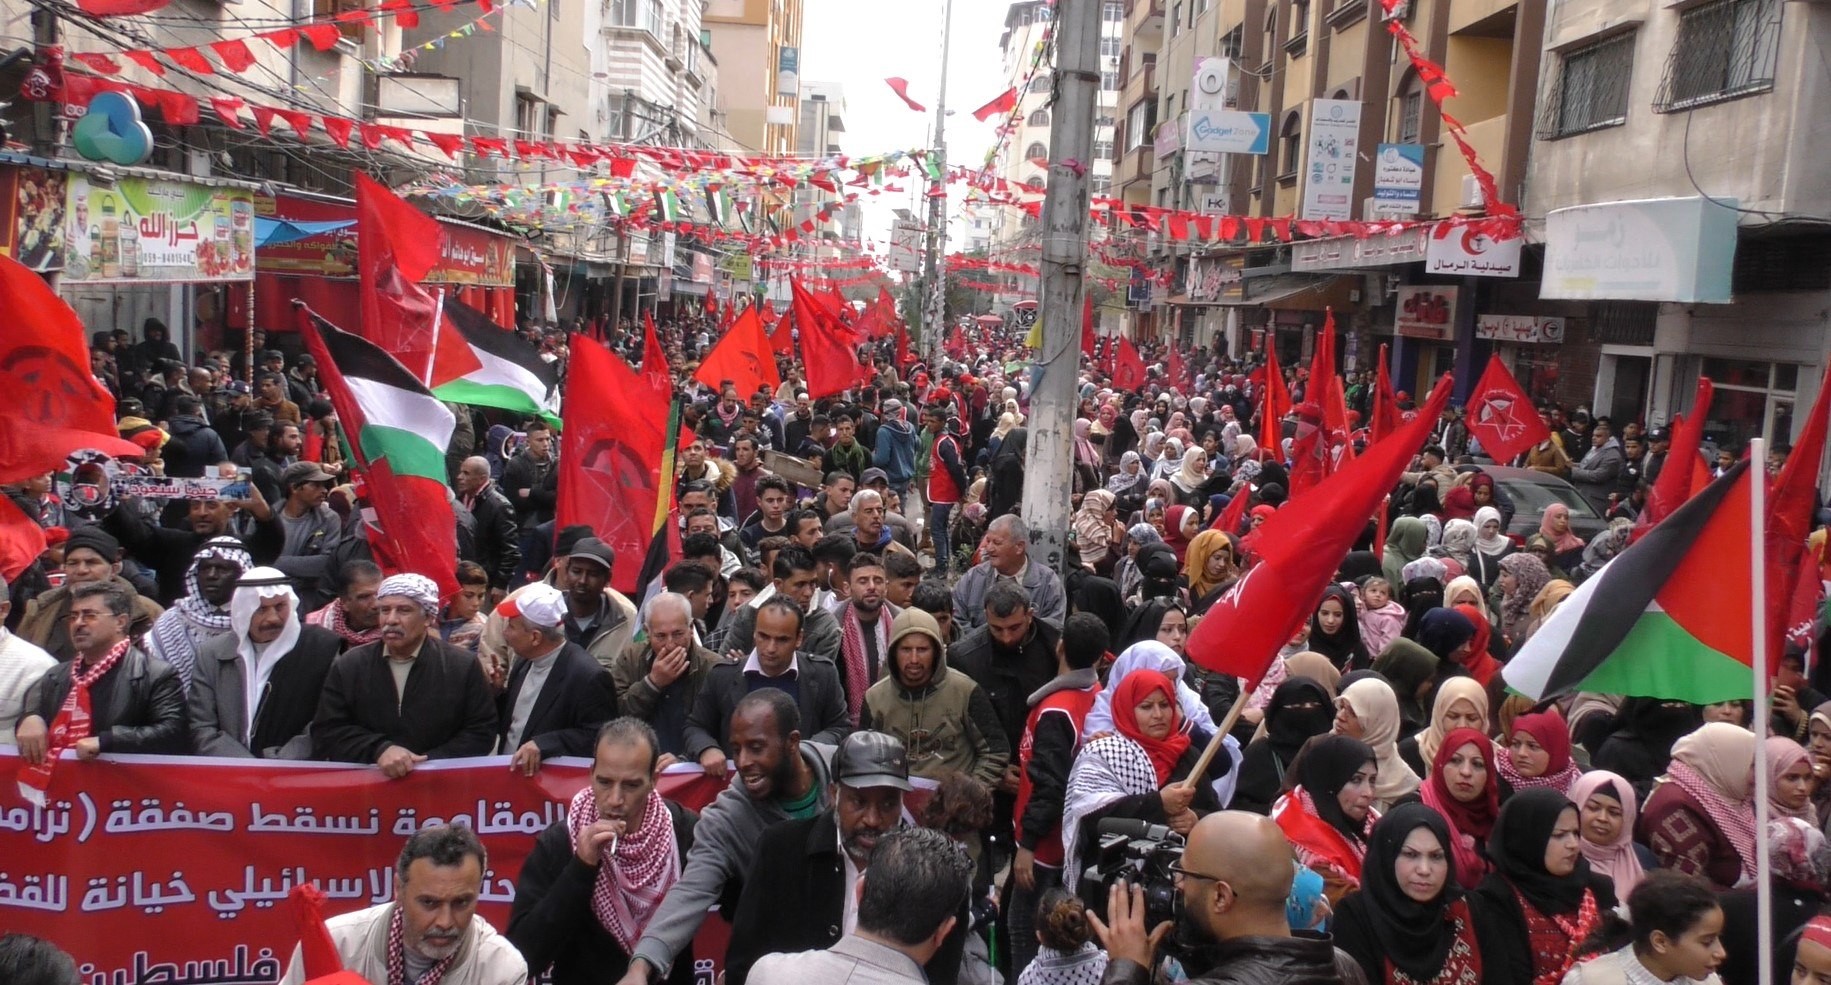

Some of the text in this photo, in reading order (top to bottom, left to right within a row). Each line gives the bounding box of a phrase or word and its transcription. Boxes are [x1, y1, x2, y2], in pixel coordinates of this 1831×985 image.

[140, 210, 199, 247] حرز الله
[1433, 259, 1512, 274] صيدلية الرمال
[105, 798, 235, 834] صفقة
[248, 802, 380, 835] نسقط
[81, 870, 196, 913] خيانة
